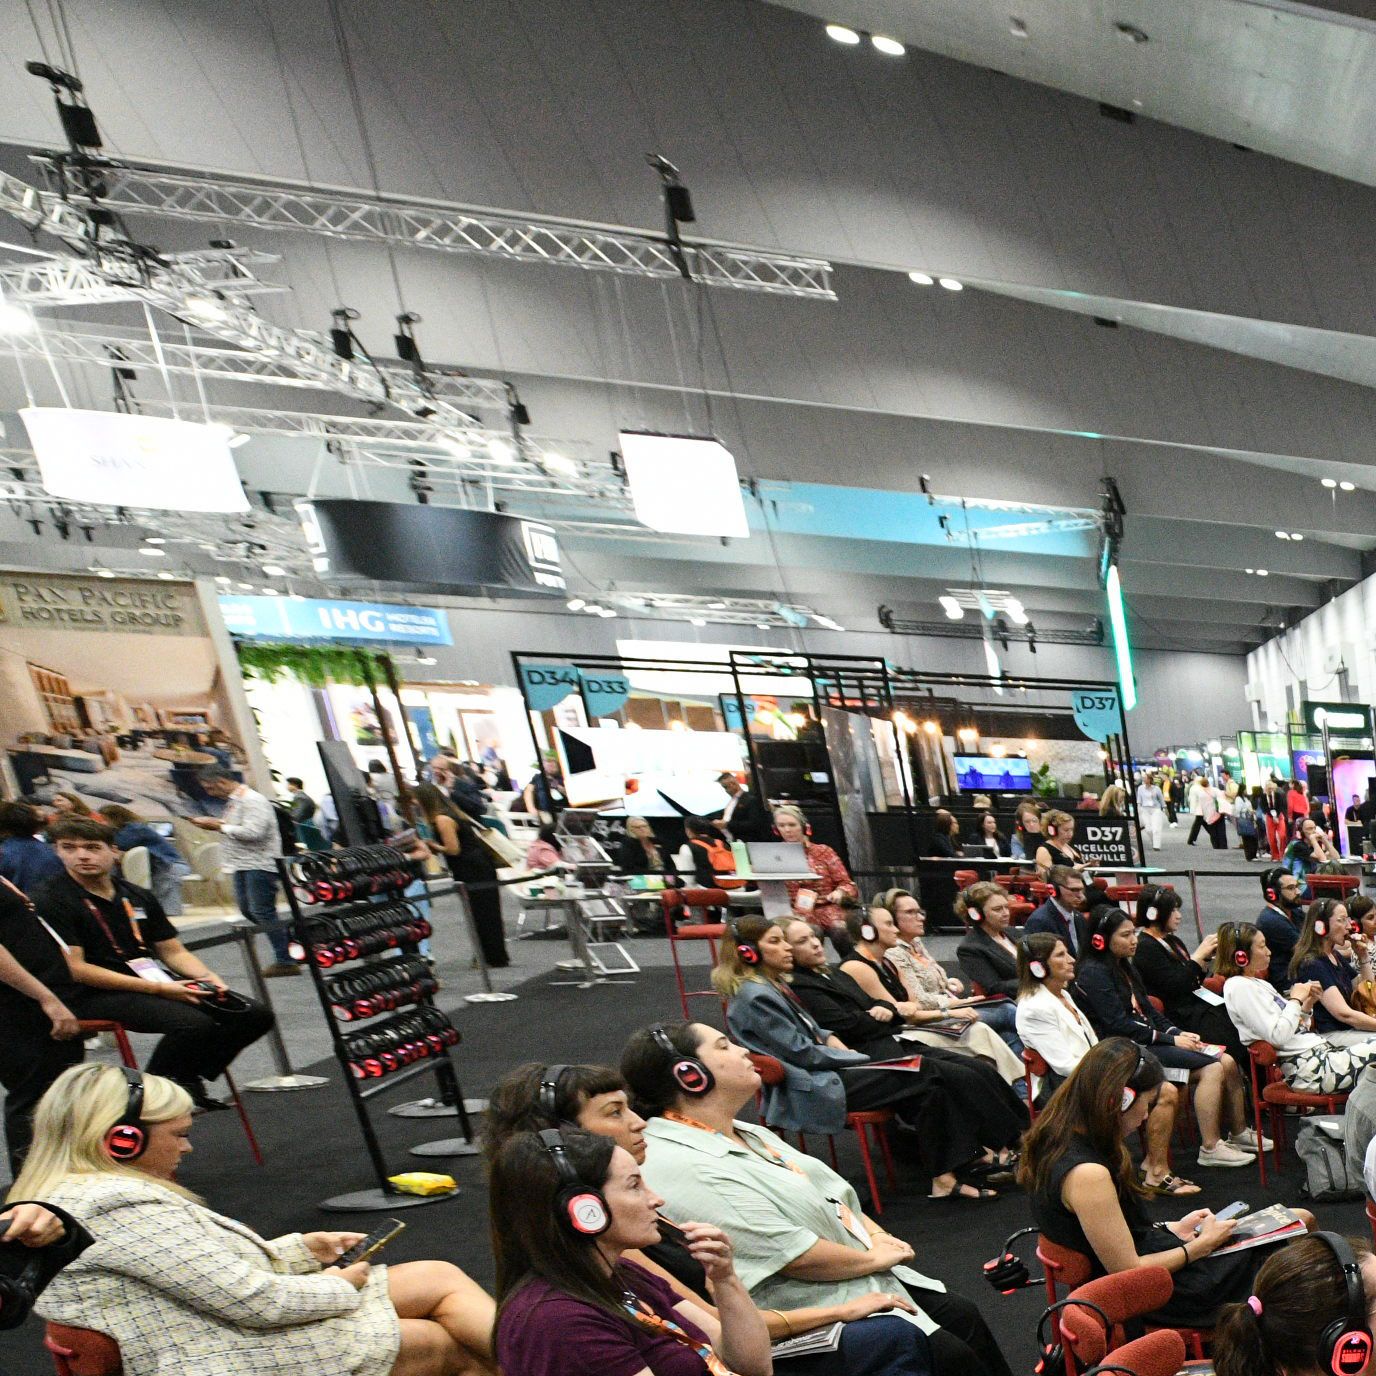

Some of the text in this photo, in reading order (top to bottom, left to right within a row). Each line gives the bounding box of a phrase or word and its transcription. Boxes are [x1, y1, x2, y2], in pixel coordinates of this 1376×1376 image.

[12, 582, 178, 611] PAN PACIFIC
[20, 605, 184, 628] HOTELS GROUP
[318, 607, 386, 633] IHG
[527, 670, 576, 687] D34
[586, 679, 628, 694] D33
[1081, 695, 1115, 711] D37
[1086, 826, 1123, 842] D37
[1075, 843, 1126, 853] NCELLOR
